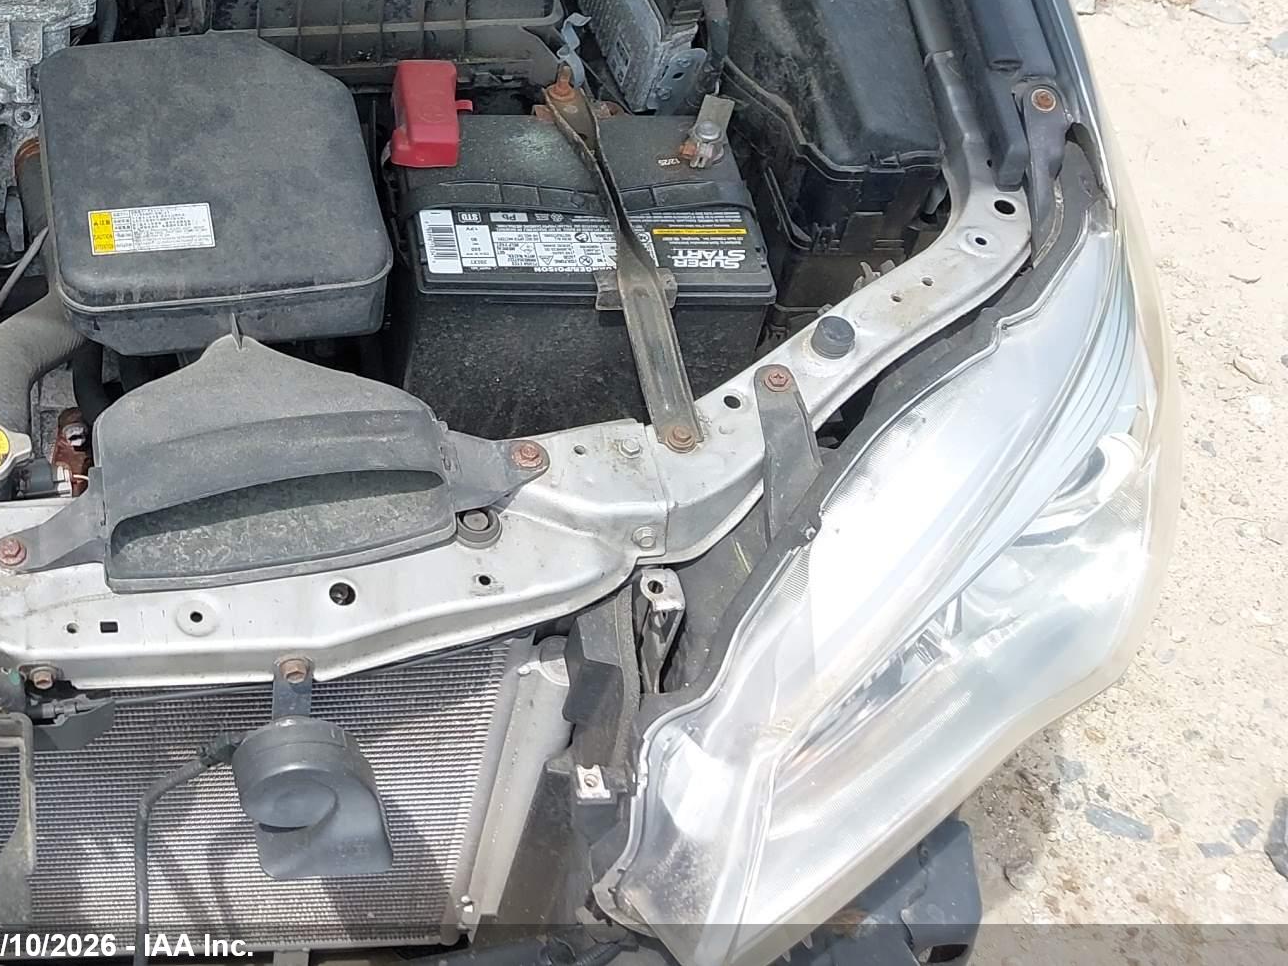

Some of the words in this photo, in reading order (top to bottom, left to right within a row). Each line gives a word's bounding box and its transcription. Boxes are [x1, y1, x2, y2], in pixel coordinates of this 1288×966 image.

[502, 213, 516, 221] Pb
[671, 249, 746, 260] START
[674, 258, 741, 269] SUPER
